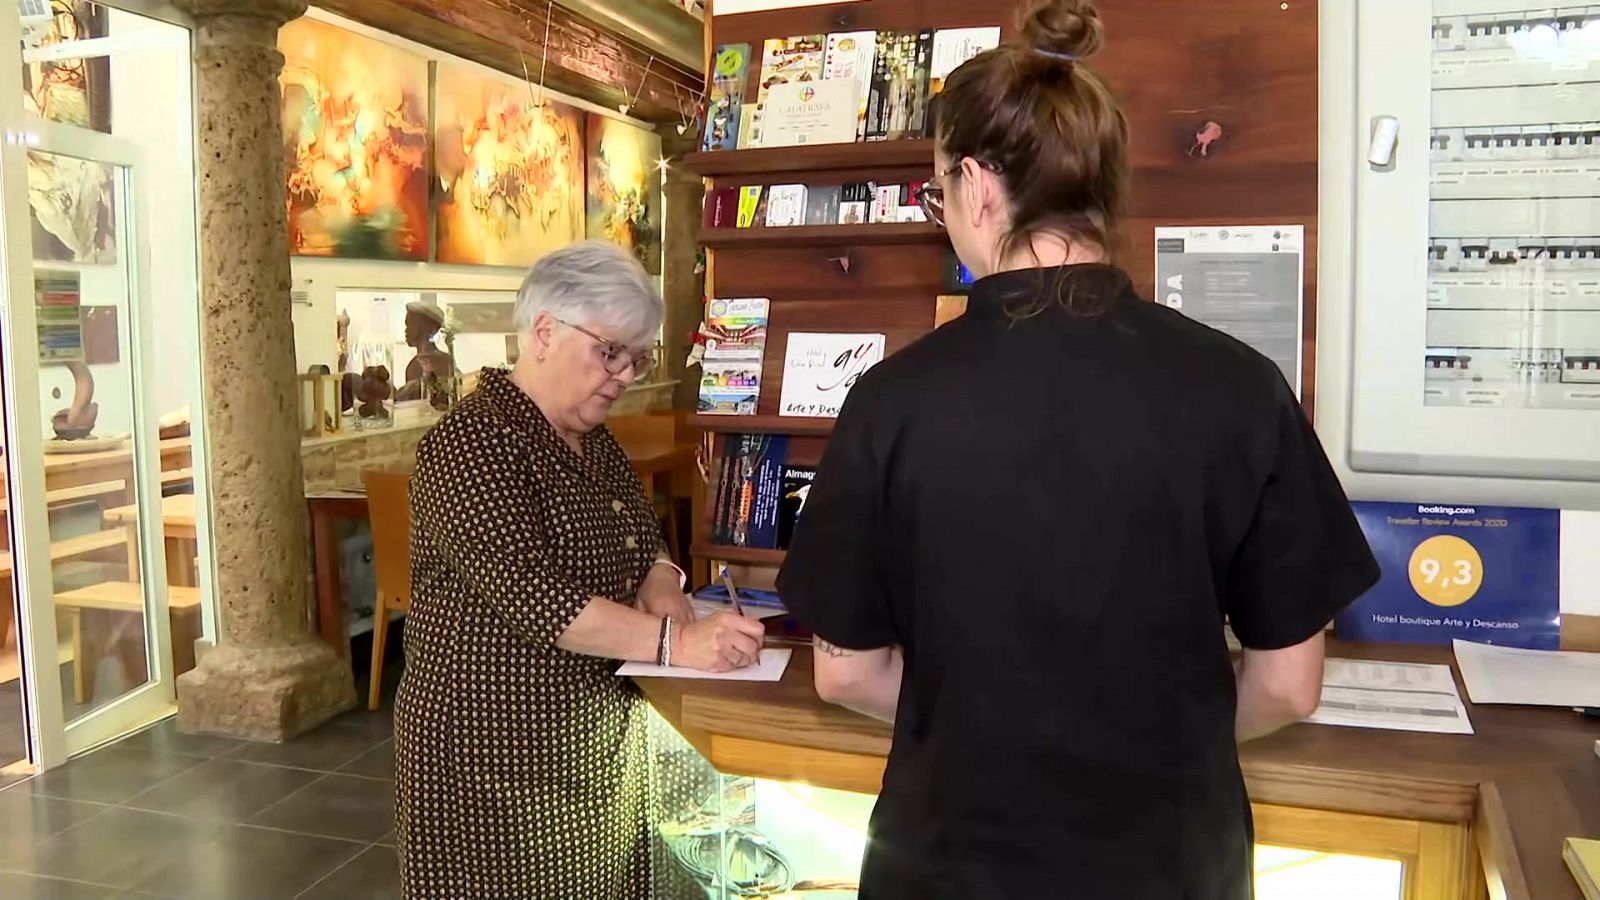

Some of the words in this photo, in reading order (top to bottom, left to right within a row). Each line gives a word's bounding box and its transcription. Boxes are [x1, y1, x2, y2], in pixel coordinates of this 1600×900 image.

[1418, 505, 1475, 515] Booking.com
[1484, 519, 1508, 527] 2020
[1420, 559, 1472, 588] 9,3
[1372, 614, 1398, 624] Hotel
[1400, 615, 1441, 626] boutique
[1443, 617, 1464, 627] Arte
[1465, 619, 1472, 629] y
[1473, 618, 1520, 630] Descanso
